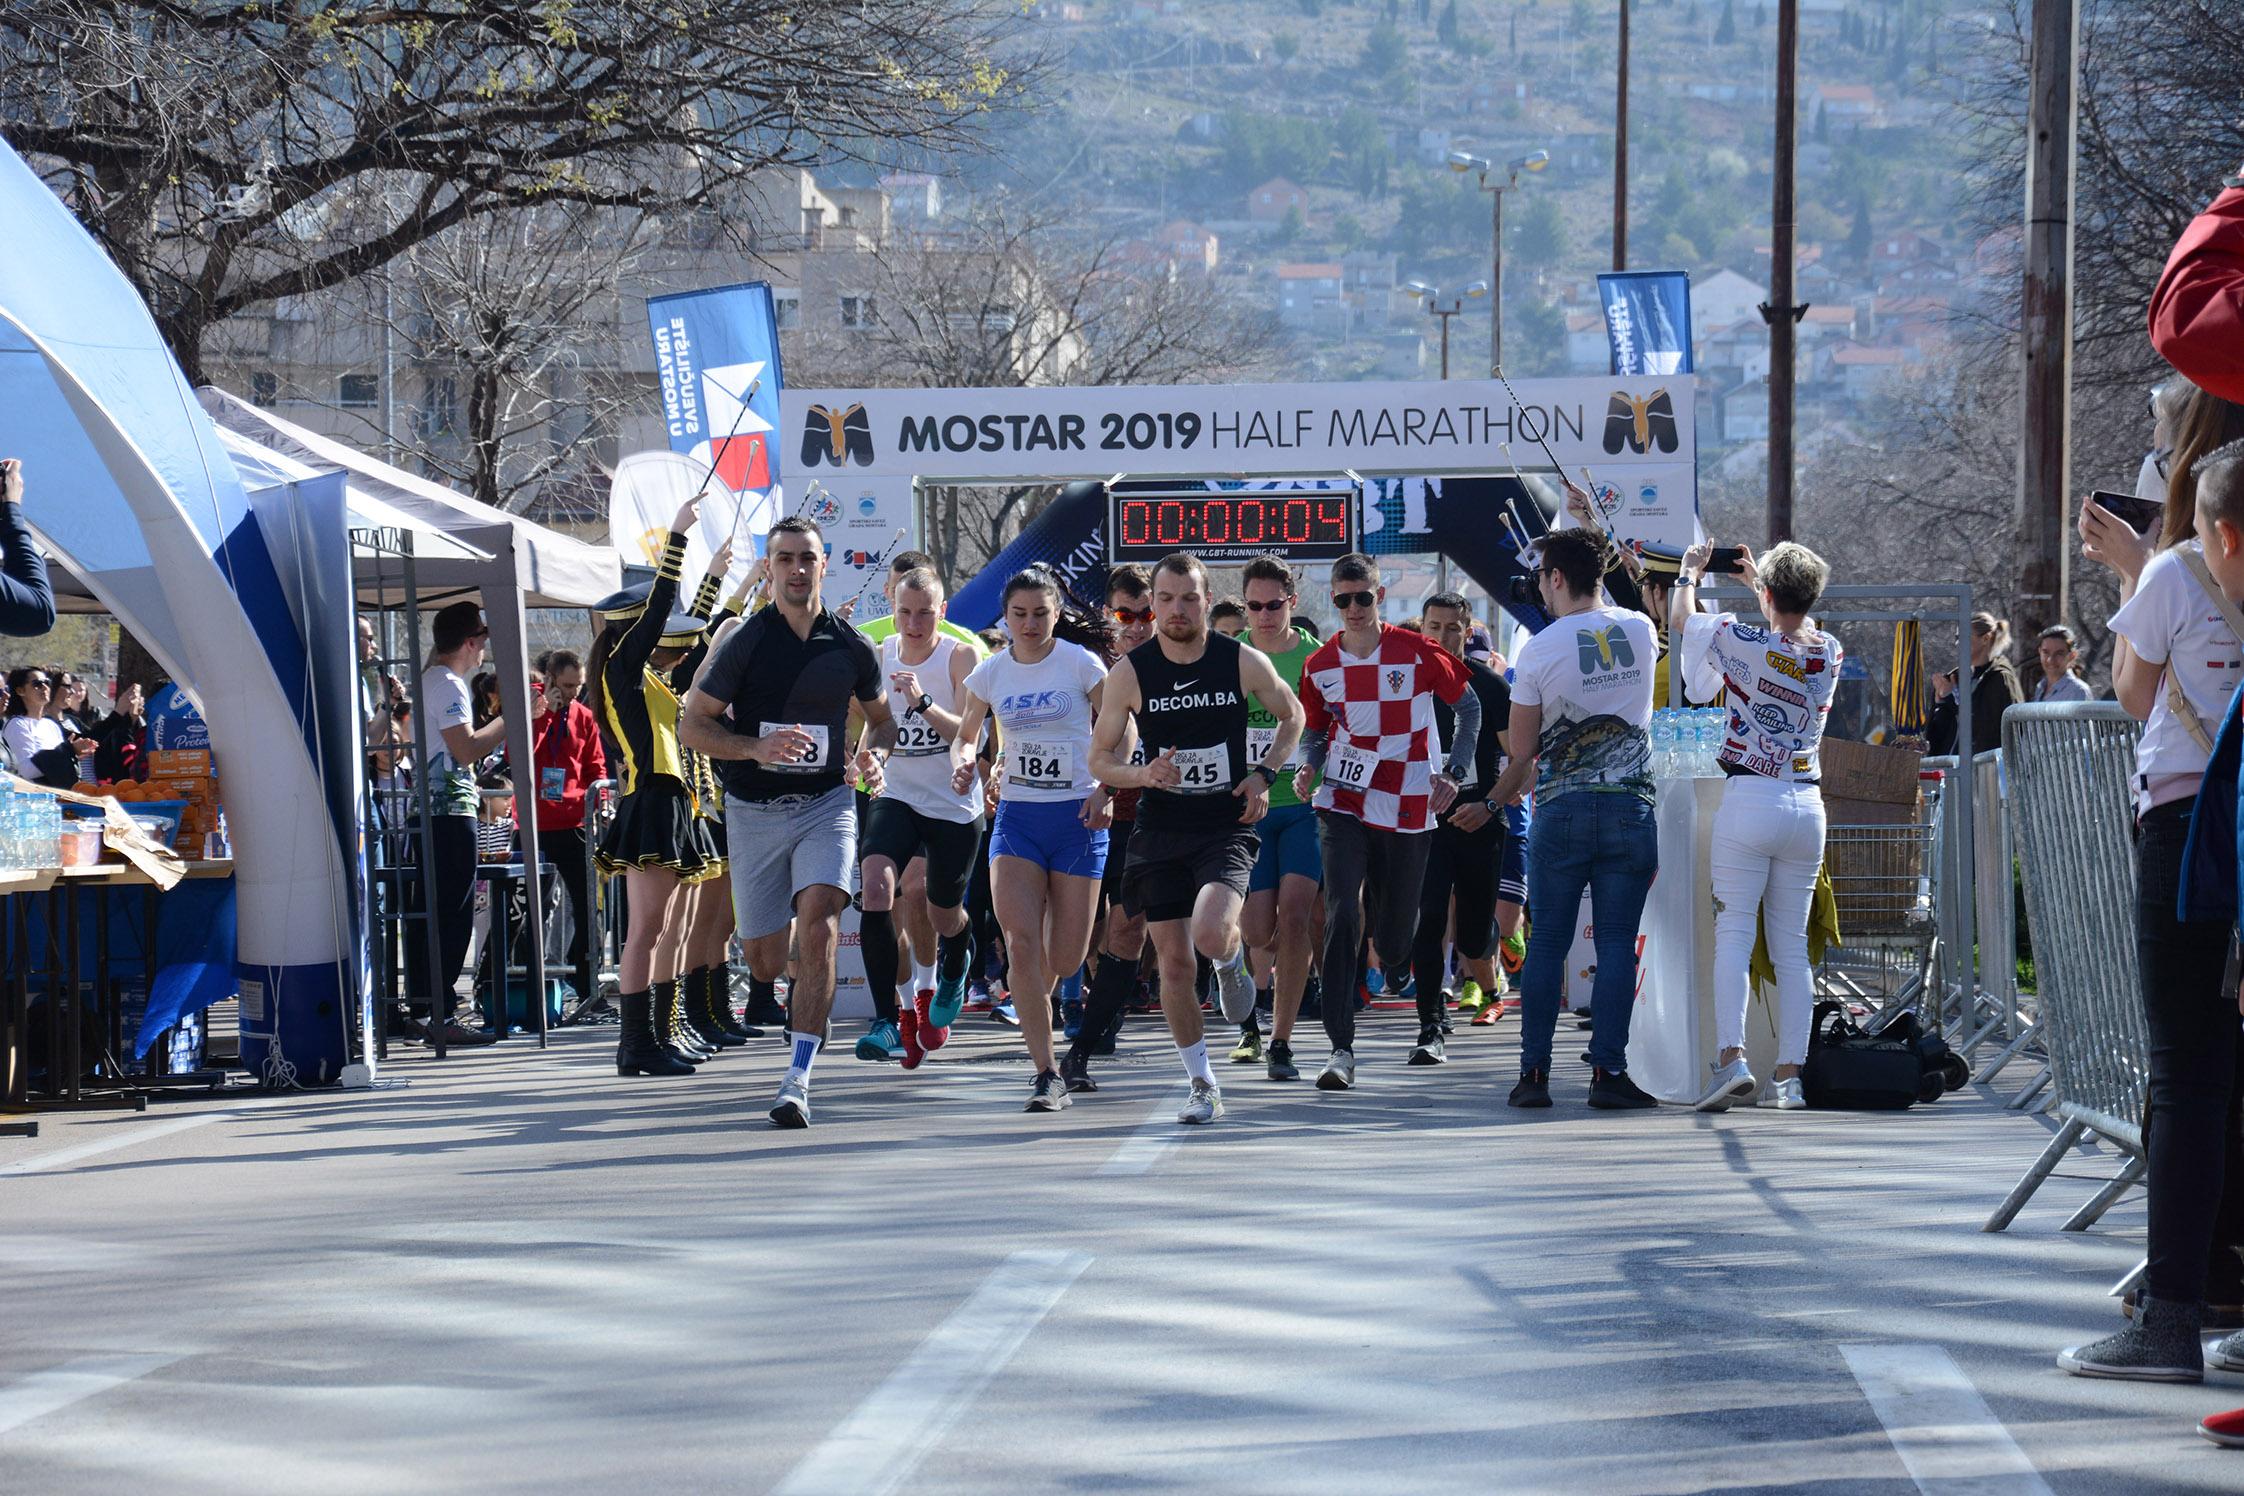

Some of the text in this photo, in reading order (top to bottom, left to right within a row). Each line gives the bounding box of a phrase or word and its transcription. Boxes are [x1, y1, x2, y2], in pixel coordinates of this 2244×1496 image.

[898, 404, 1584, 452] MOSTAR 2019 HALF MARATHON
[1123, 500, 1345, 543] 00:00:04
[1179, 547, 1289, 558] WWW.GBT-RUNNING.COM
[1582, 669, 1641, 688] MOSTAR 2019
[1000, 690, 1056, 712] ASK
[1149, 691, 1237, 712] DECOM.BA
[1753, 703, 1777, 718] KEEP
[1755, 713, 1795, 733] SMILING
[897, 727, 941, 746] 029
[796, 742, 819, 764] 8
[1018, 756, 1061, 778] 184
[1176, 762, 1218, 786] 45
[1338, 759, 1364, 782] 118
[1745, 754, 1782, 778] DARE
